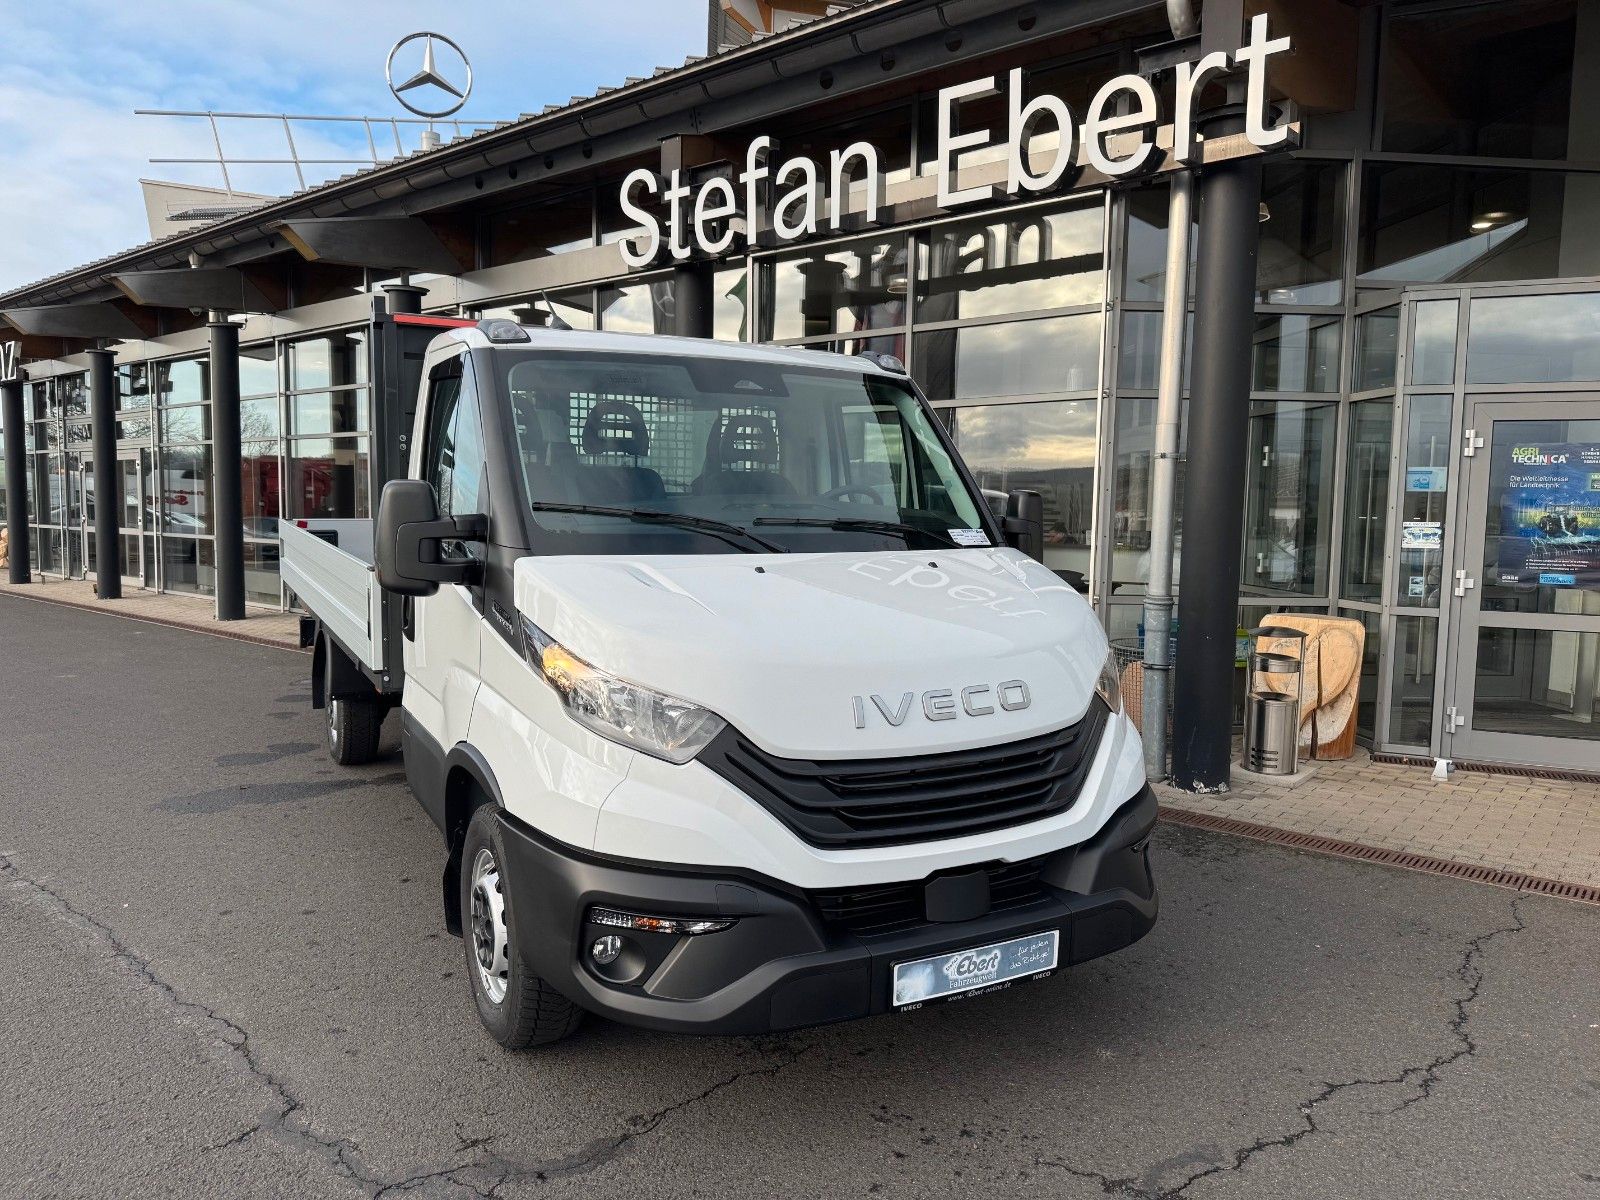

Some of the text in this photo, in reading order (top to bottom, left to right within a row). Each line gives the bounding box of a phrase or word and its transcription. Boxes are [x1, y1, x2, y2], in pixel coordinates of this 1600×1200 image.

[618, 134, 880, 268] Stefan
[936, 12, 1292, 208] Ebert
[852, 679, 1032, 729] IVECO
[956, 952, 999, 977] Ebert
[1010, 961, 1022, 970] das
[949, 970, 998, 989] Fahrzeugwelt
[1032, 970, 1051, 981] IVECO
[900, 1002, 922, 1012] IVECO
